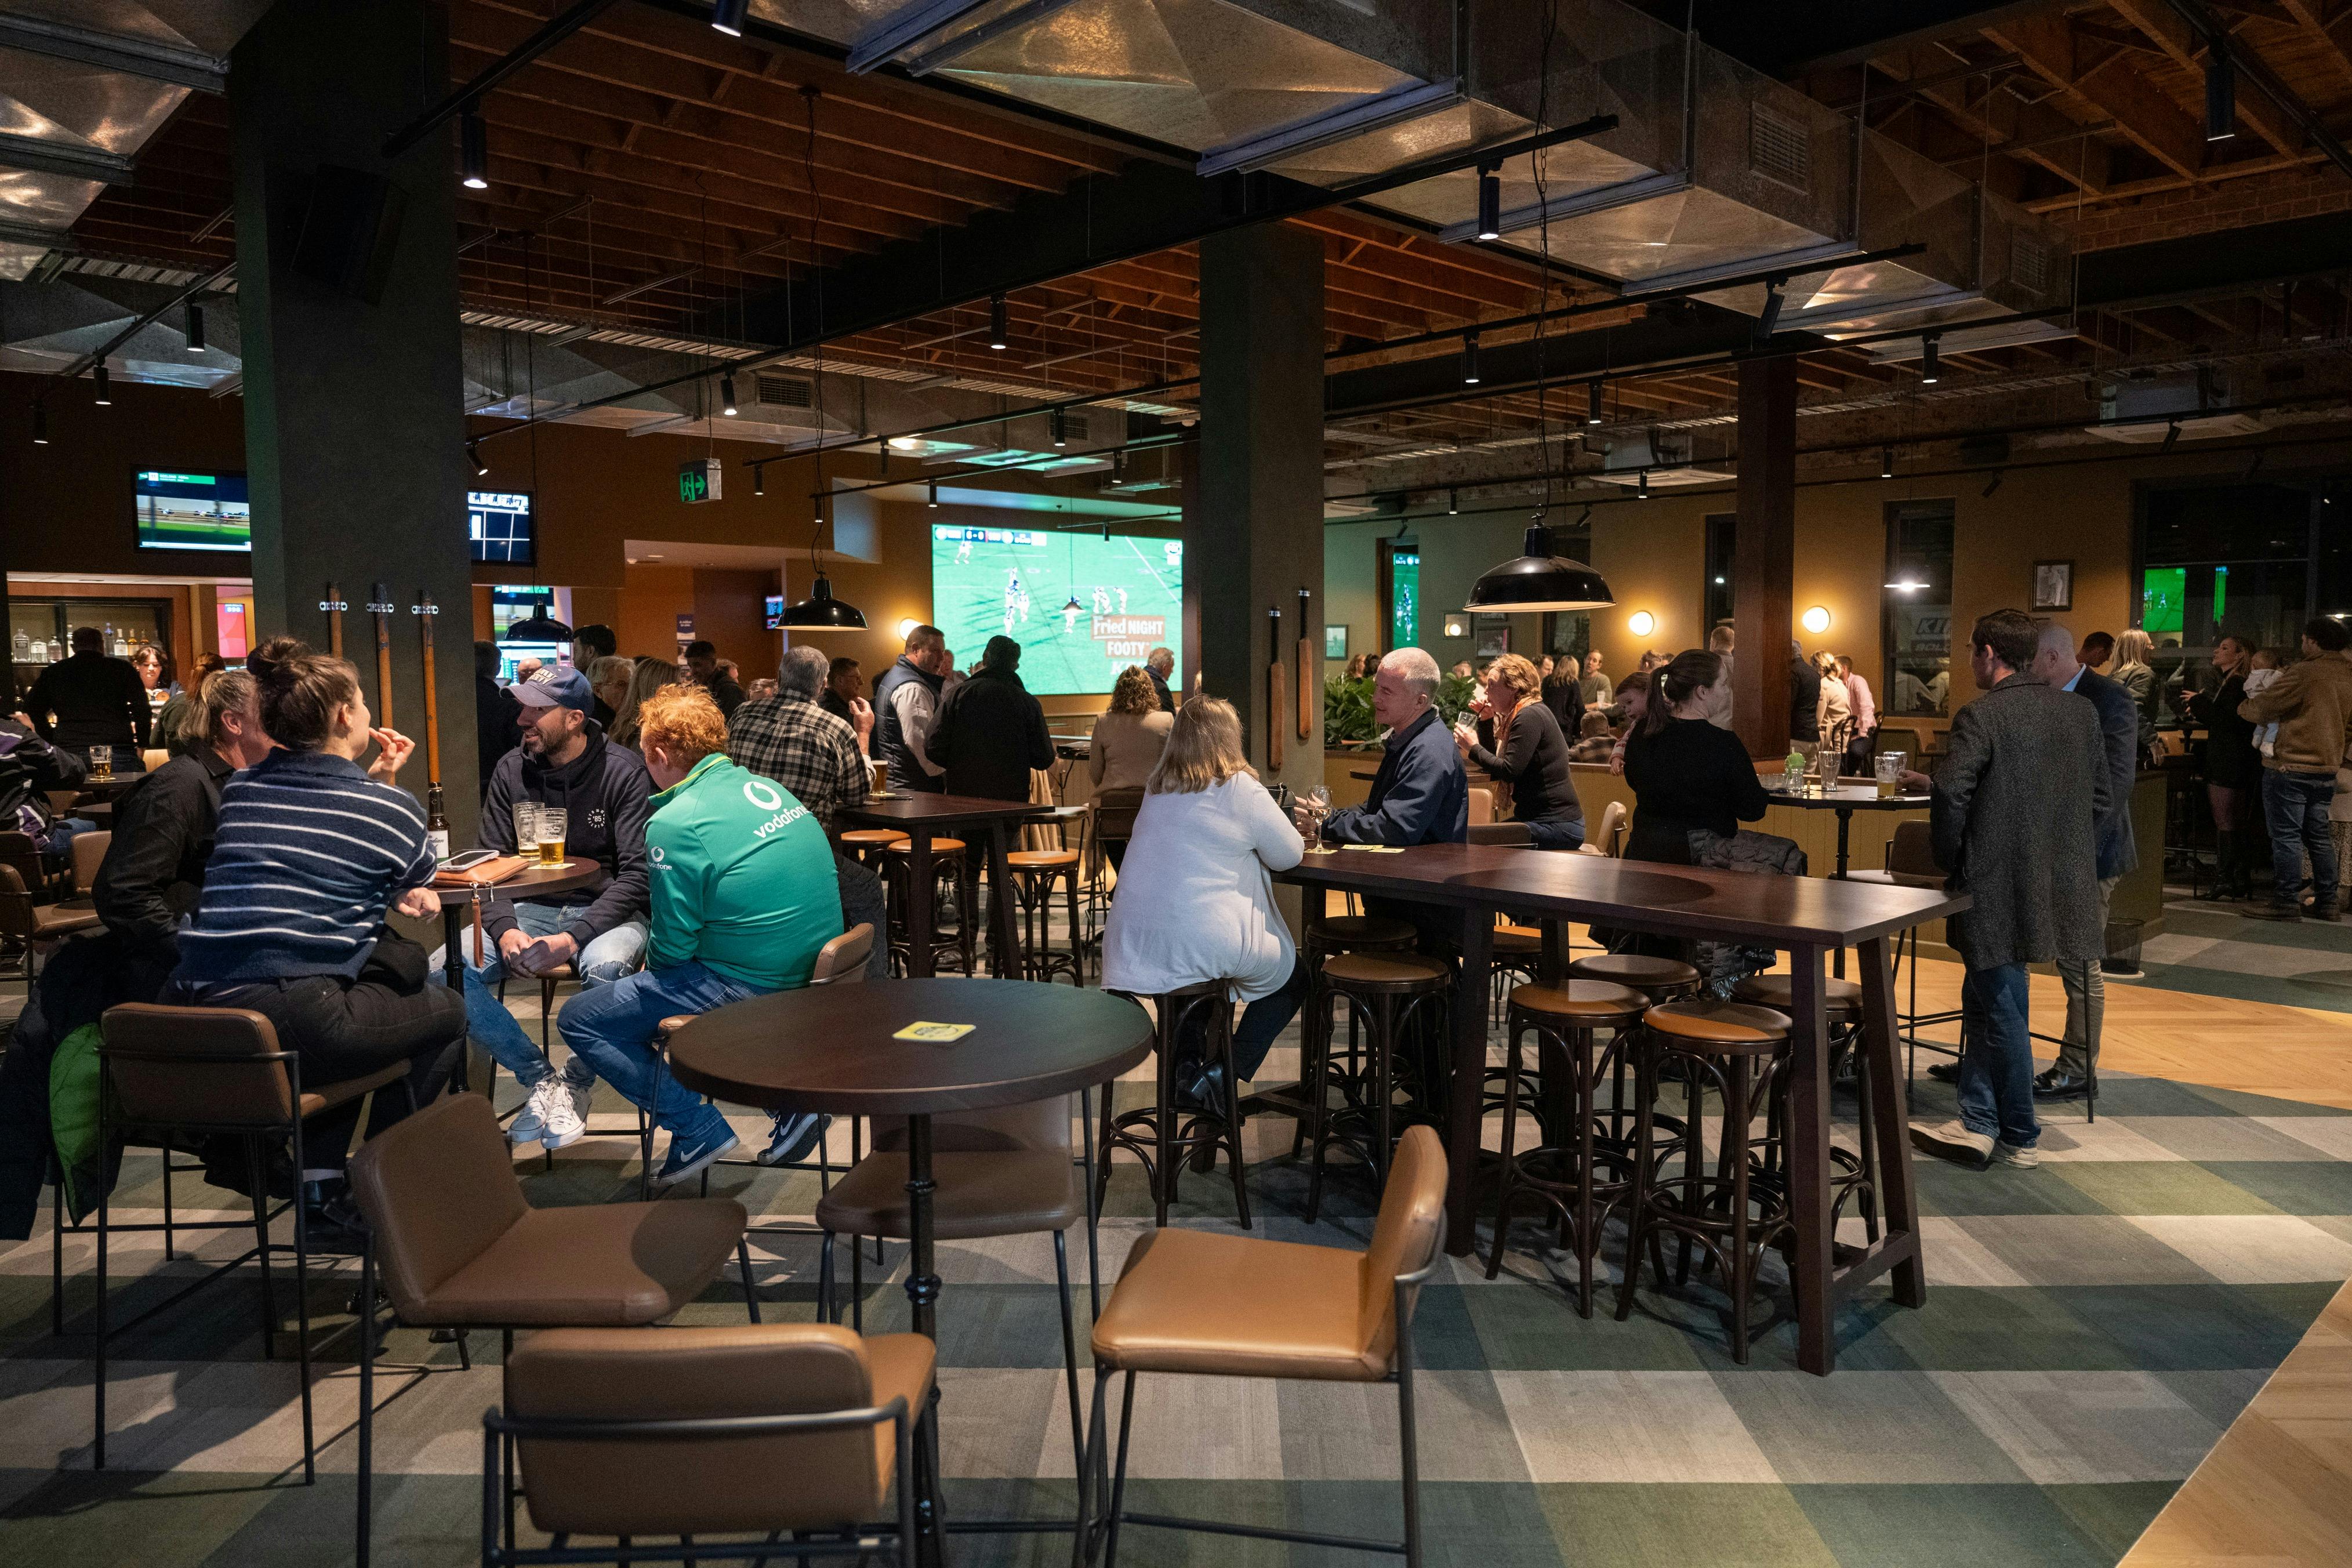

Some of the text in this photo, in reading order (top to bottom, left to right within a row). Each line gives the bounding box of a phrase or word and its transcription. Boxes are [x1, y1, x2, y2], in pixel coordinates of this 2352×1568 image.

[1093, 616, 1163, 635] Fried NIGHT
[753, 805, 810, 839] vodafone
